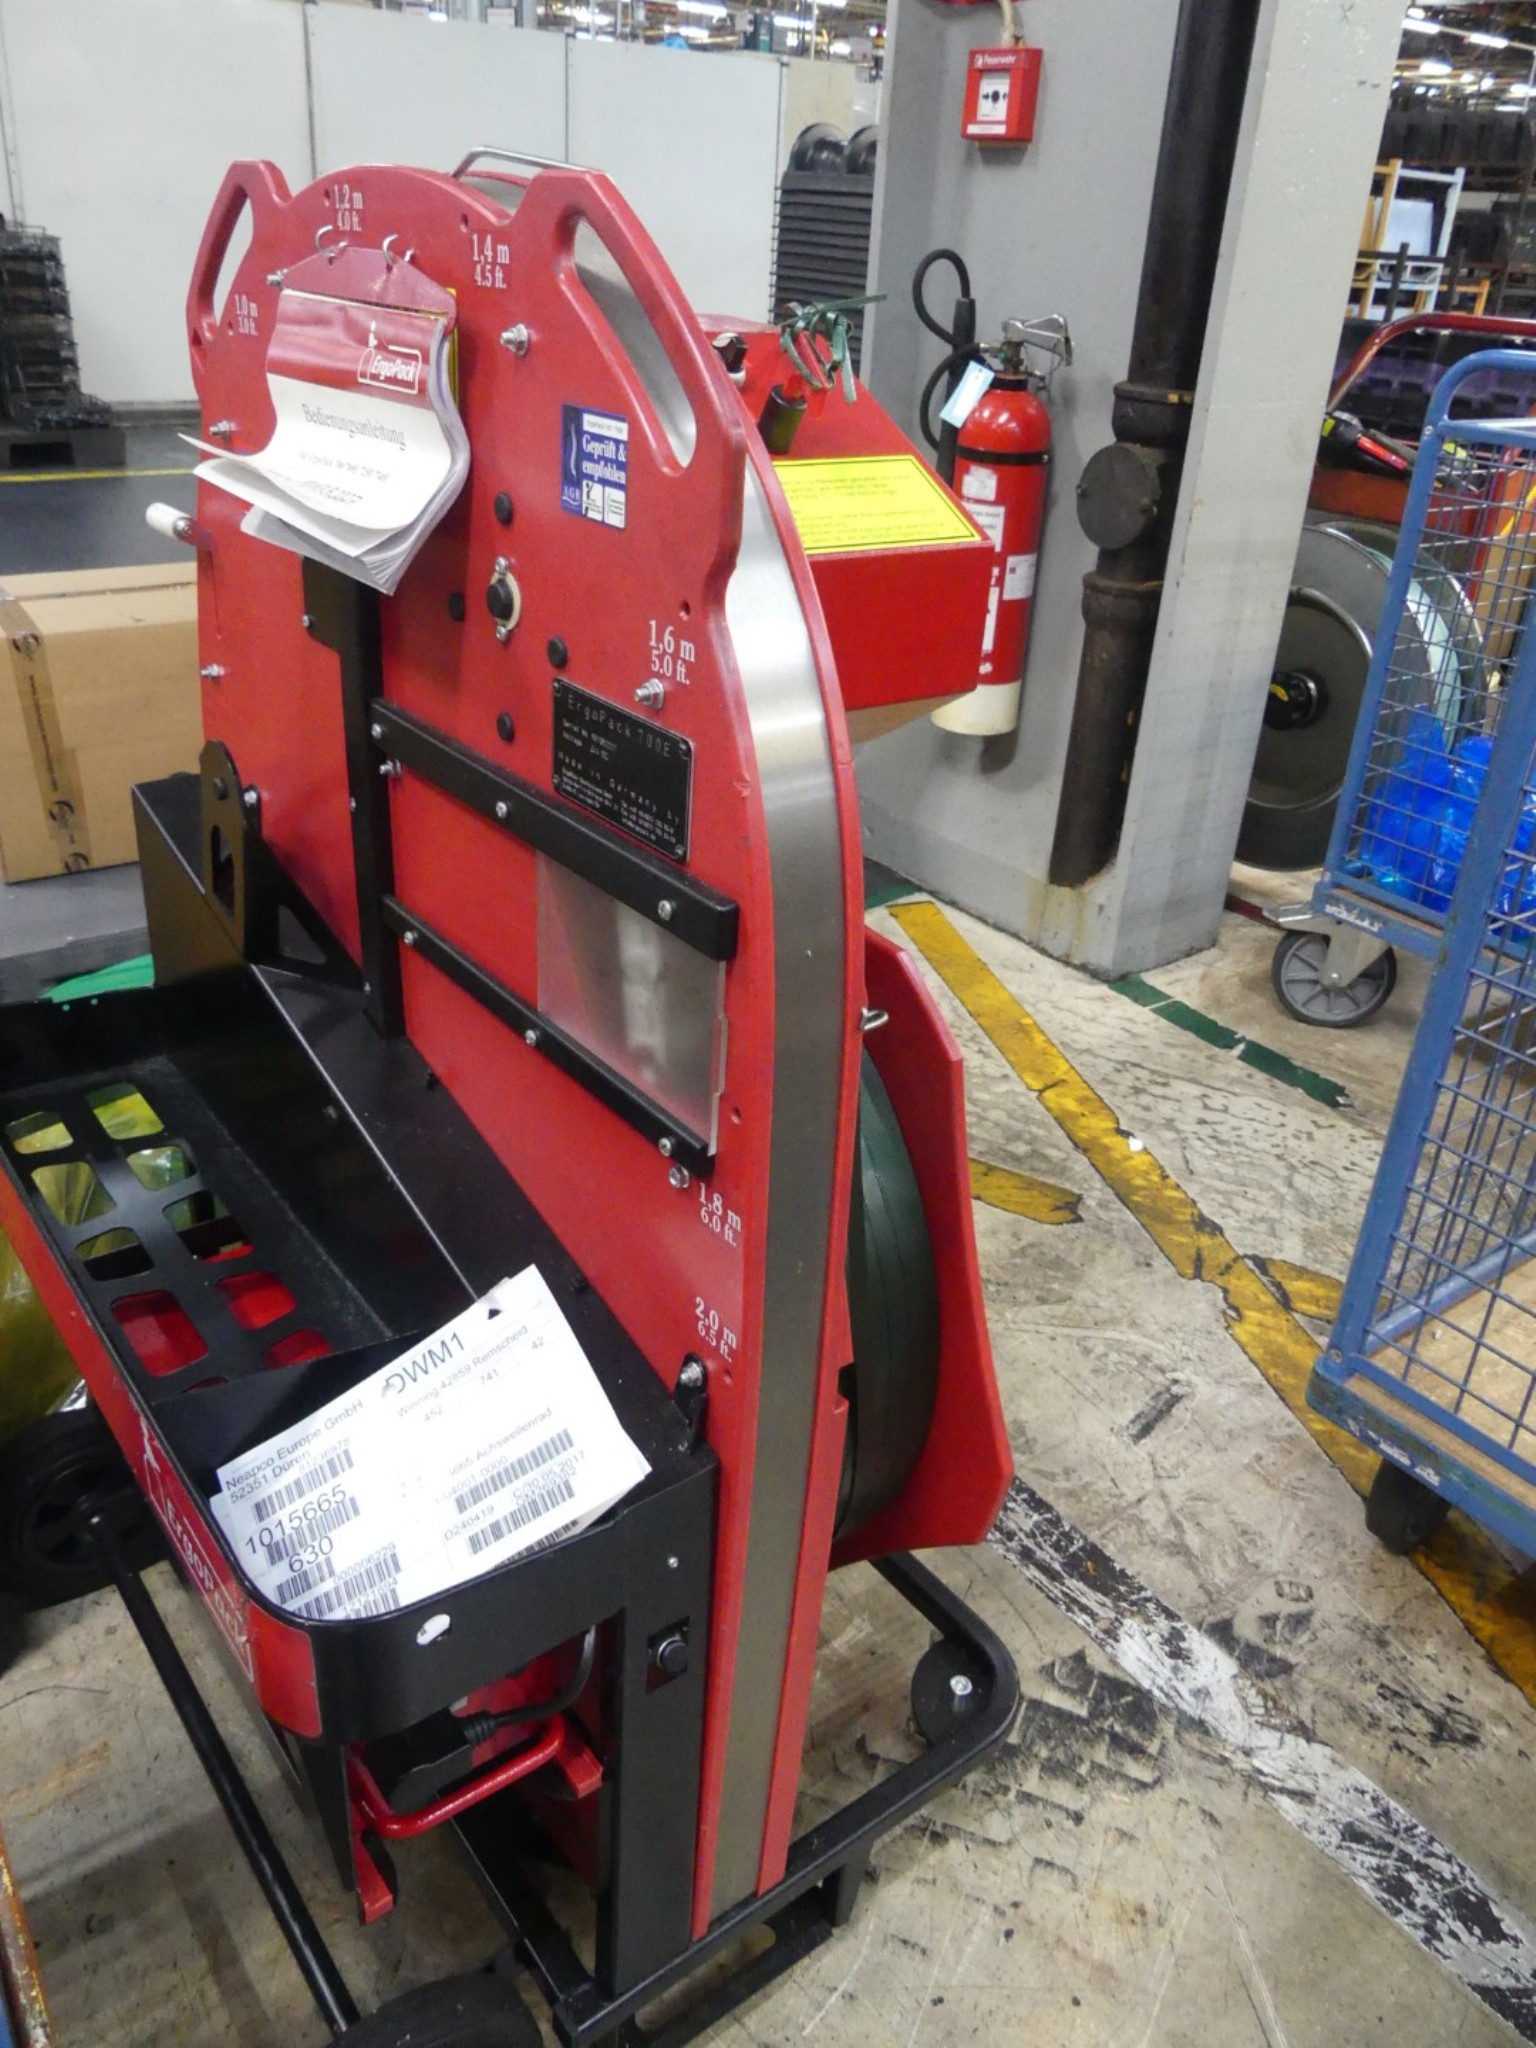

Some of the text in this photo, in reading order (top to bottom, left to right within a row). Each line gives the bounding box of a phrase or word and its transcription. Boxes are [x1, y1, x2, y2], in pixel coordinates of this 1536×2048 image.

[334, 184, 363, 209] 1,2 m
[472, 233, 510, 266] 1,4 m
[475, 263, 507, 289] 4.5 ft.
[371, 355, 416, 382] ErgoPack
[583, 434, 627, 462] Geprüft &
[582, 460, 626, 485] empfohlen
[649, 619, 695, 662] 1,6 m
[651, 649, 690, 685] 5.0 ft.
[568, 694, 631, 738] ErgoPack
[699, 1182, 742, 1232] 1,8 m
[701, 1206, 737, 1247] 6.0 ft.
[695, 1296, 737, 1349] 2,0 m
[697, 1320, 732, 1363] 6.5 ft.
[472, 1325, 529, 1367] Remscheid
[479, 1368, 499, 1385] 741
[531, 1336, 545, 1350] 42
[225, 1399, 364, 1491] Neapco Europe GmbH
[230, 1450, 311, 1504] 52351 Düren
[245, 1484, 346, 1554] 1015665
[444, 1504, 495, 1541] D240419
[289, 1535, 333, 1573] 630
